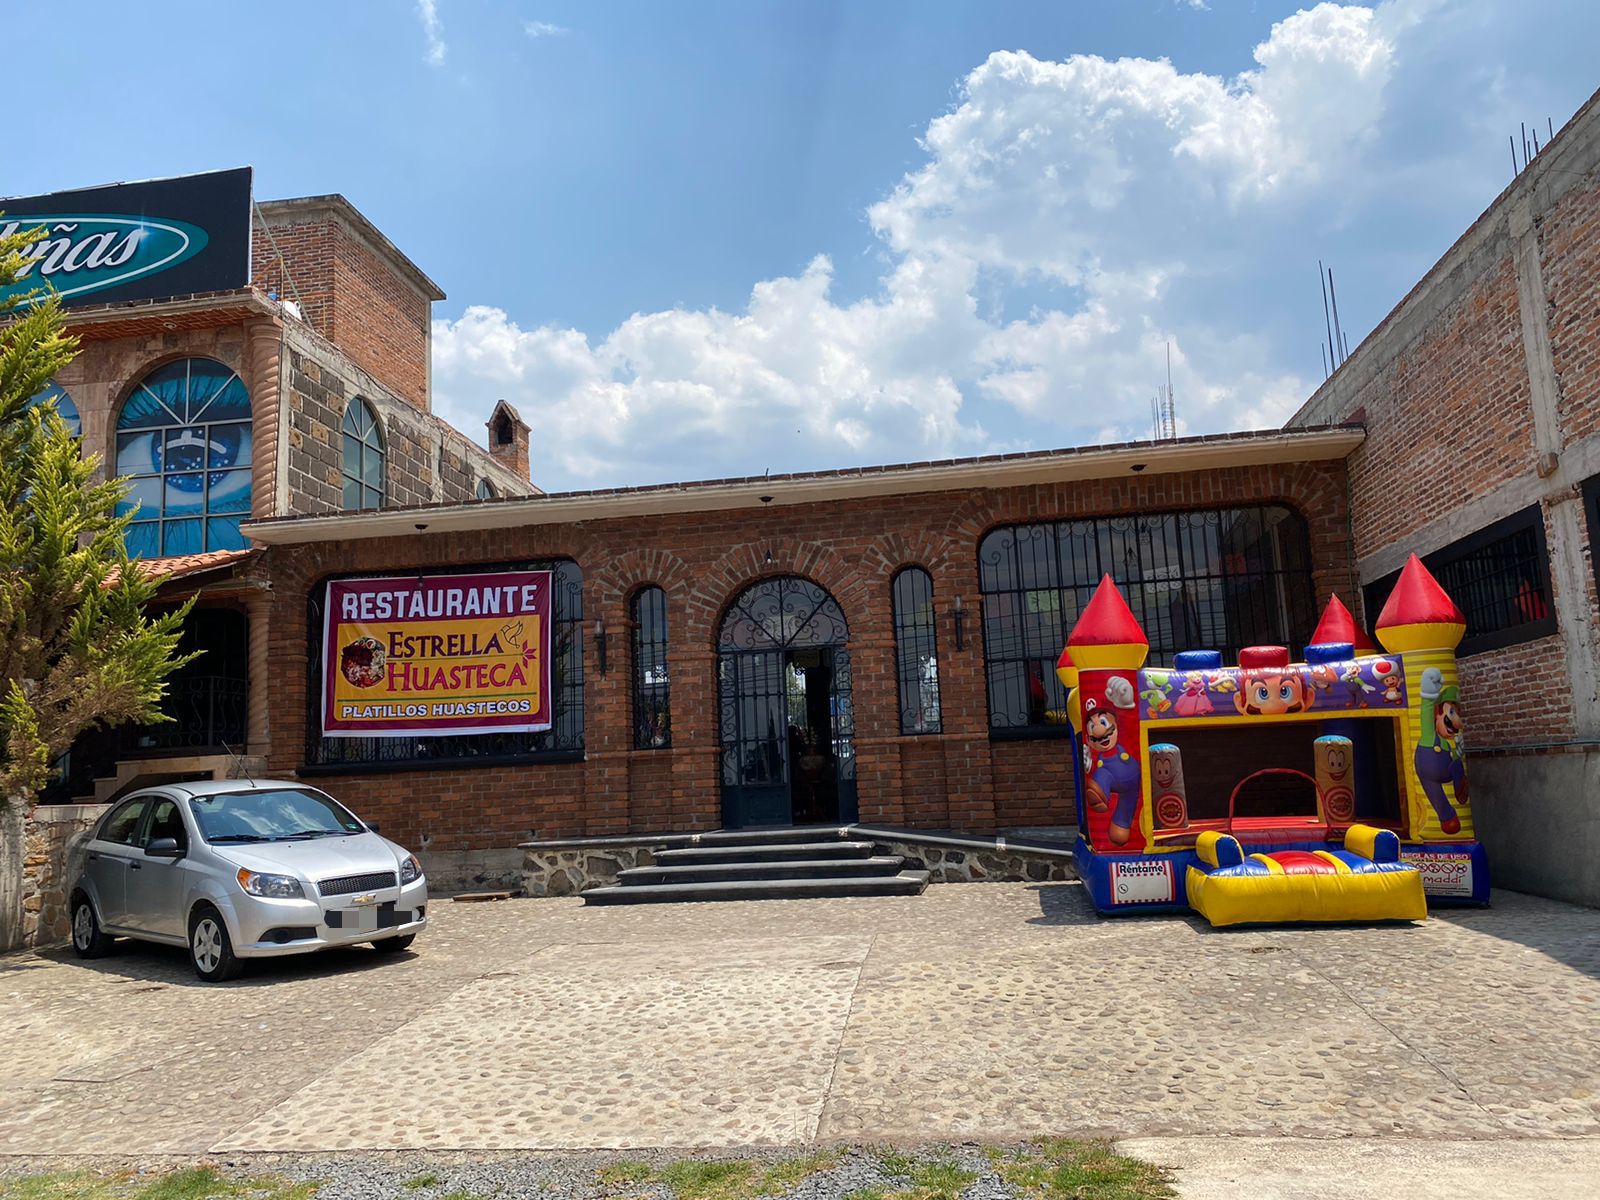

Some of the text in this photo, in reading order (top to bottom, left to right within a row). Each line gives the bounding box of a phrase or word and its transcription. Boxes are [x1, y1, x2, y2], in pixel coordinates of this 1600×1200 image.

[342, 584, 537, 620] RESTAURANTE
[387, 631, 504, 659] ESTRELLA
[386, 661, 527, 692] HUASTECA
[342, 700, 531, 719] PLATILLOS HUASTECOS
